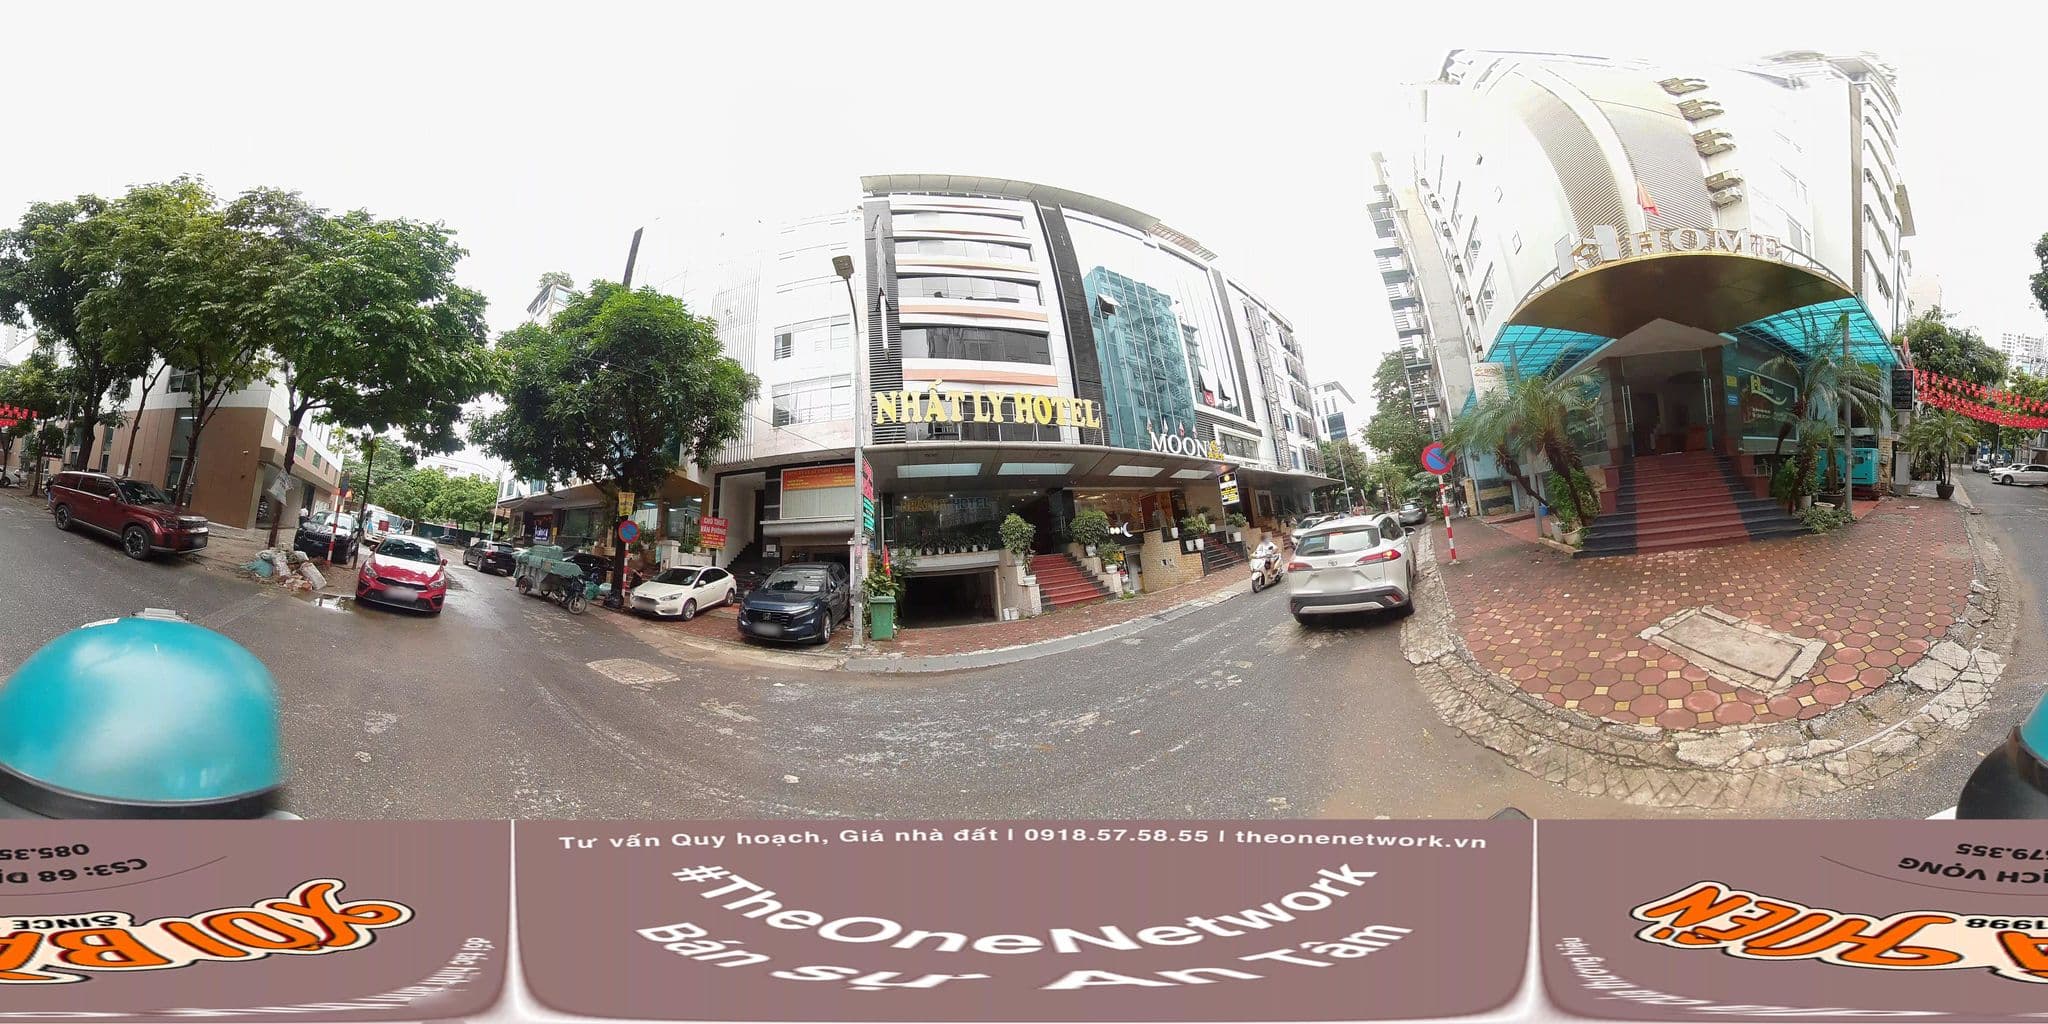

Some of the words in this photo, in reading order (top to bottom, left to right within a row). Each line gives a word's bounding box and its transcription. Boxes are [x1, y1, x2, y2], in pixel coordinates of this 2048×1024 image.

[1630, 227, 1783, 262] HOME
[875, 378, 965, 425] NHẤT
[971, 390, 1006, 424] LY
[1012, 391, 1101, 429] HOTEL
[1150, 431, 1209, 458] MOON
